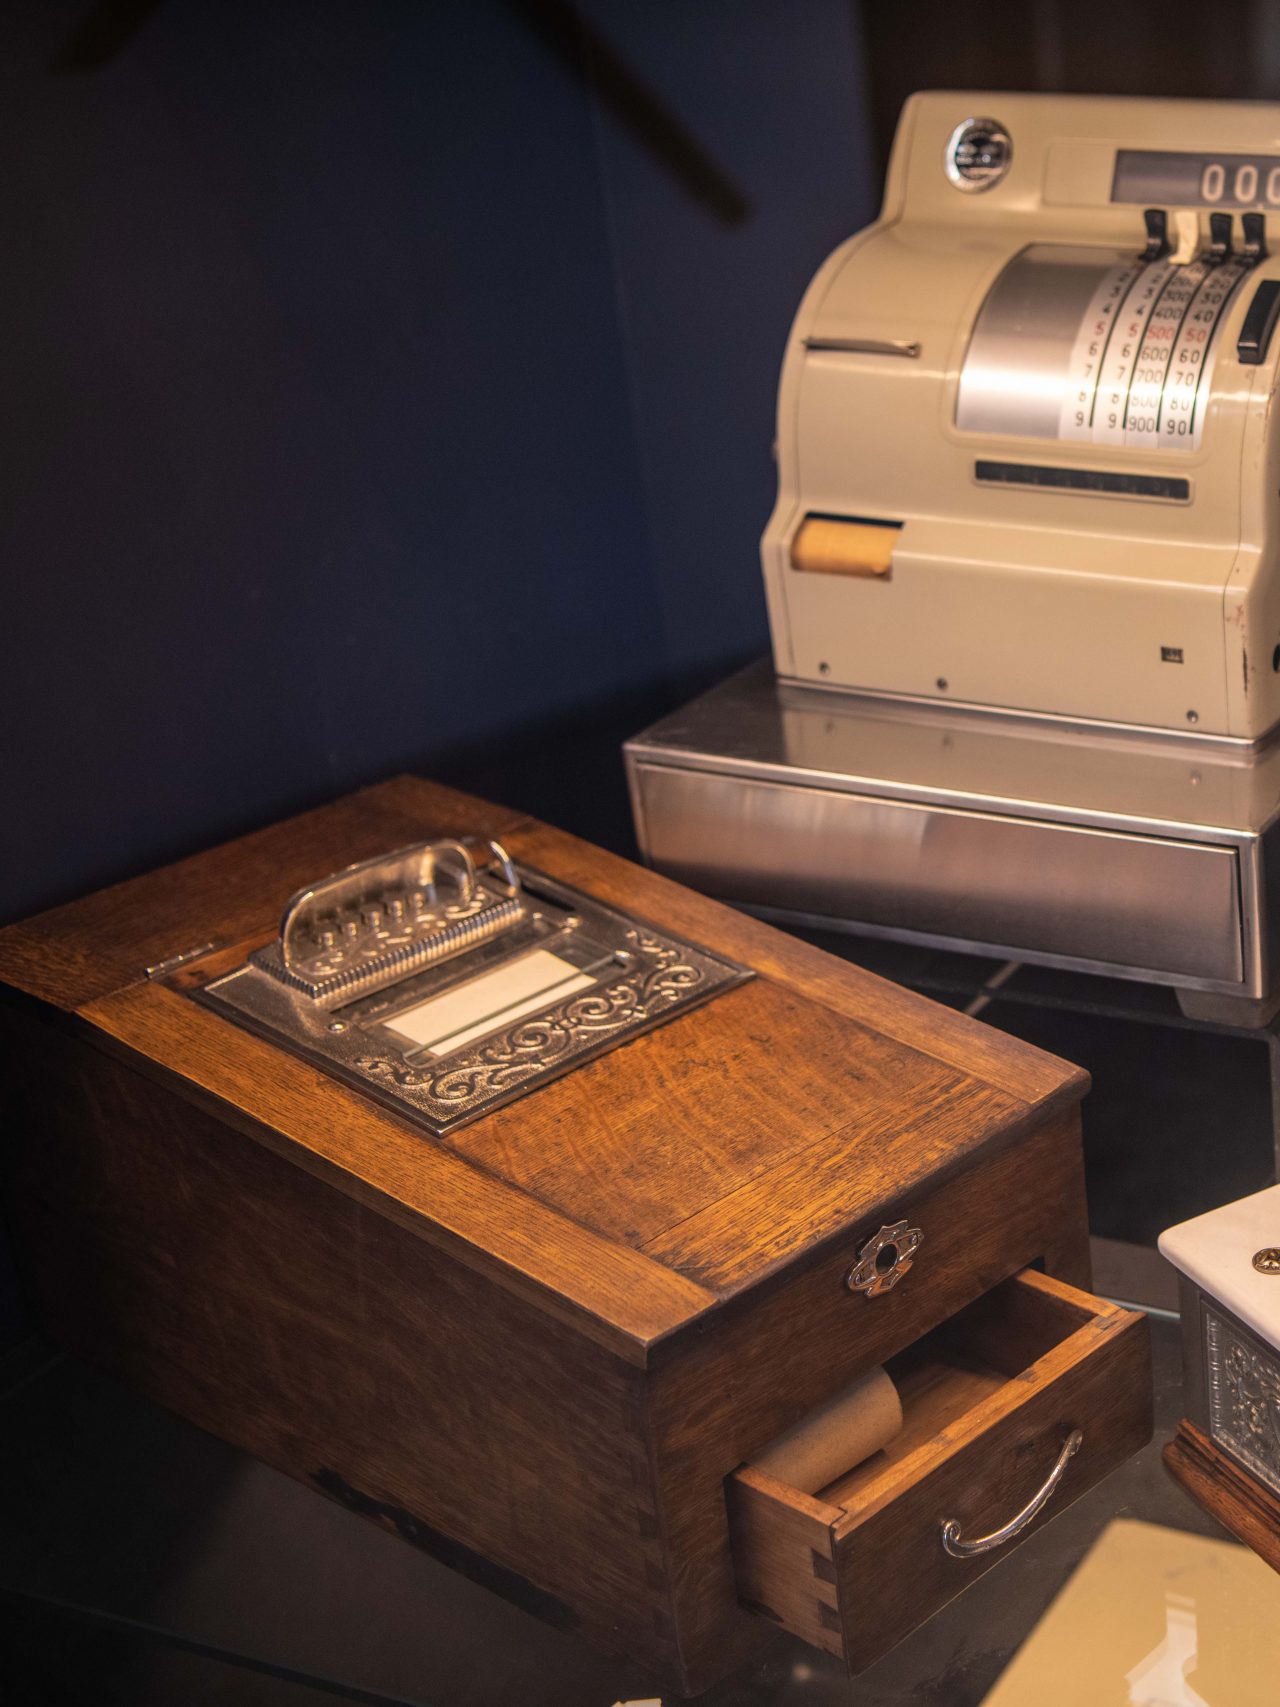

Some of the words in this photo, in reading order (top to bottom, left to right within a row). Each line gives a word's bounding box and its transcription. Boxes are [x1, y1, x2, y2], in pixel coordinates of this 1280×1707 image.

[1102, 303, 1112, 315] 4
[1136, 305, 1145, 317] 4
[1155, 307, 1184, 321] 400
[1193, 309, 1214, 324] 40
[1095, 320, 1106, 336] 5
[1129, 322, 1139, 337] 5
[1147, 325, 1175, 340] 500
[1185, 328, 1207, 343] 50
[1089, 342, 1099, 356] 6
[1122, 343, 1131, 358] 6
[1141, 346, 1169, 362] 600
[1179, 348, 1200, 364] 60
[1085, 363, 1093, 378] 7
[1118, 365, 1126, 380] 7
[1137, 369, 1163, 384] 700
[1176, 371, 1195, 387] 70
[1075, 411, 1084, 427] 9
[1108, 413, 1117, 429] 9
[1129, 416, 1155, 433] 900
[1166, 419, 1187, 436] 90
